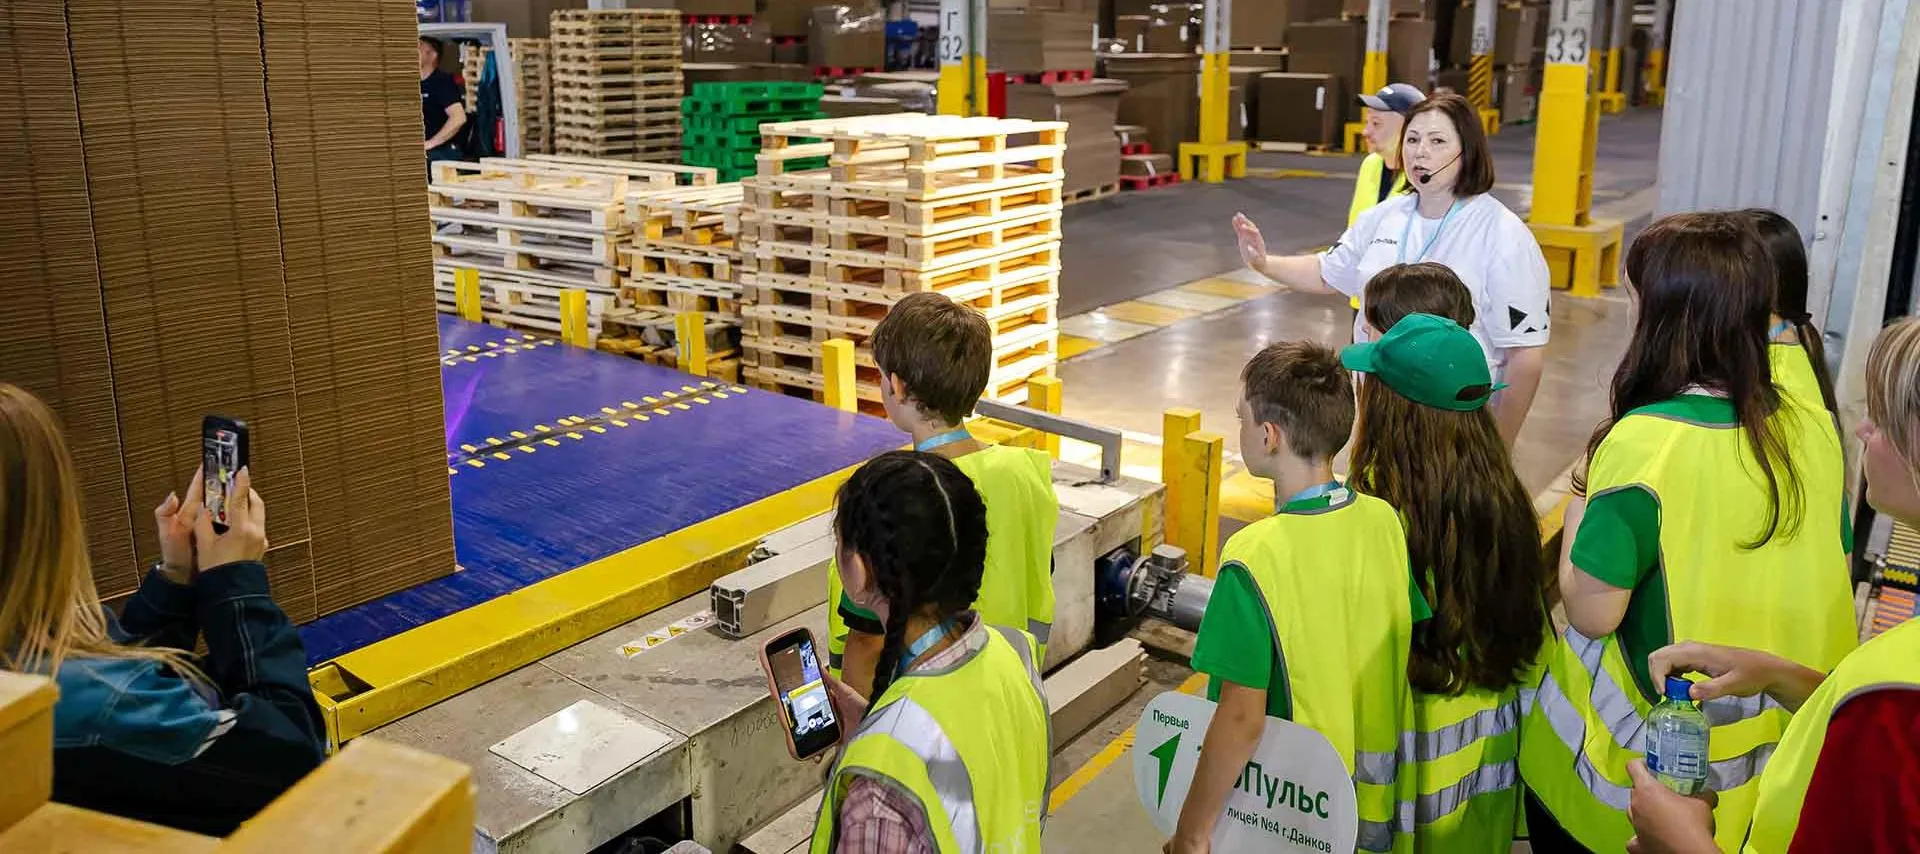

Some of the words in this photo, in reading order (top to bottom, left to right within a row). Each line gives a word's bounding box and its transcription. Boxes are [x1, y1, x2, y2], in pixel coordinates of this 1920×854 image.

[942, 35, 963, 60] 32
[1548, 27, 1587, 62] 33
[1153, 709, 1190, 730] Первые
[1227, 807, 1259, 827] лицей
[1260, 816, 1280, 834] №4
[1282, 827, 1332, 853] г.Данков
